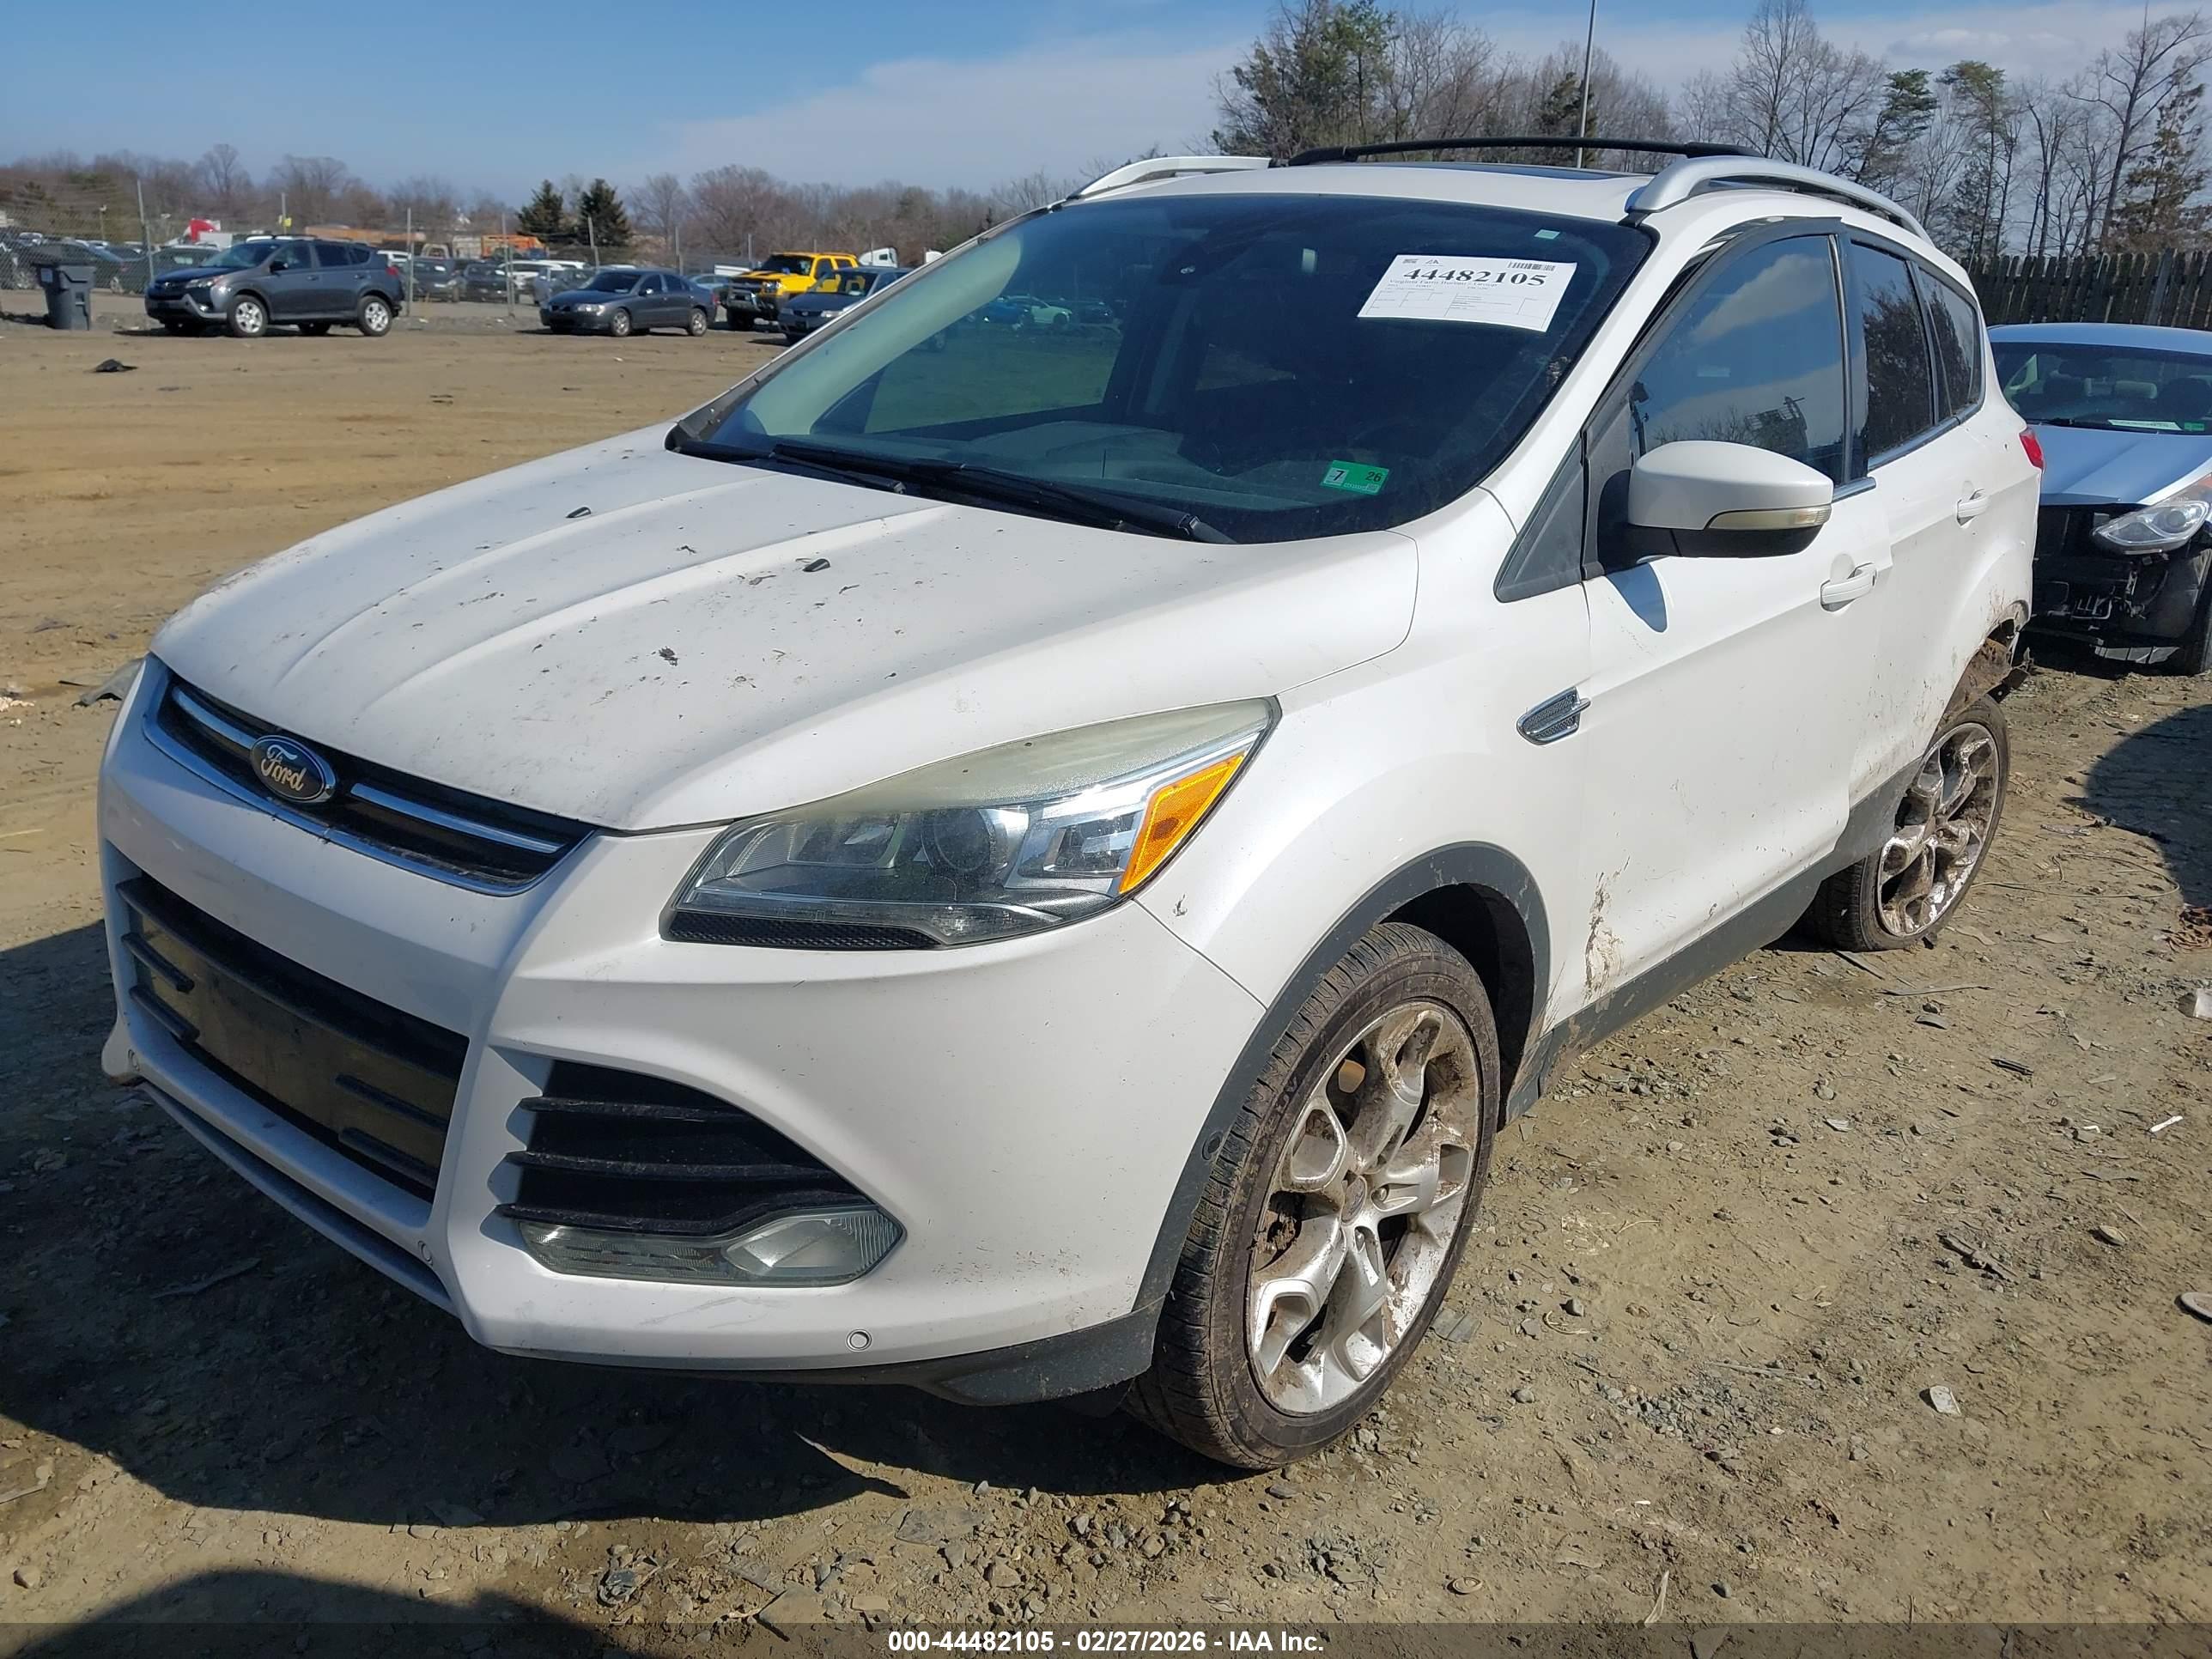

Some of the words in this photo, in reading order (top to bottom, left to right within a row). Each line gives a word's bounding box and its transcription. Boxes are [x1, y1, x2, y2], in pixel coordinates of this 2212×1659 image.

[1403, 268, 1547, 287] 44482105
[1333, 470, 1345, 482] 7
[1365, 471, 1383, 483] 26
[260, 744, 307, 792] Ford
